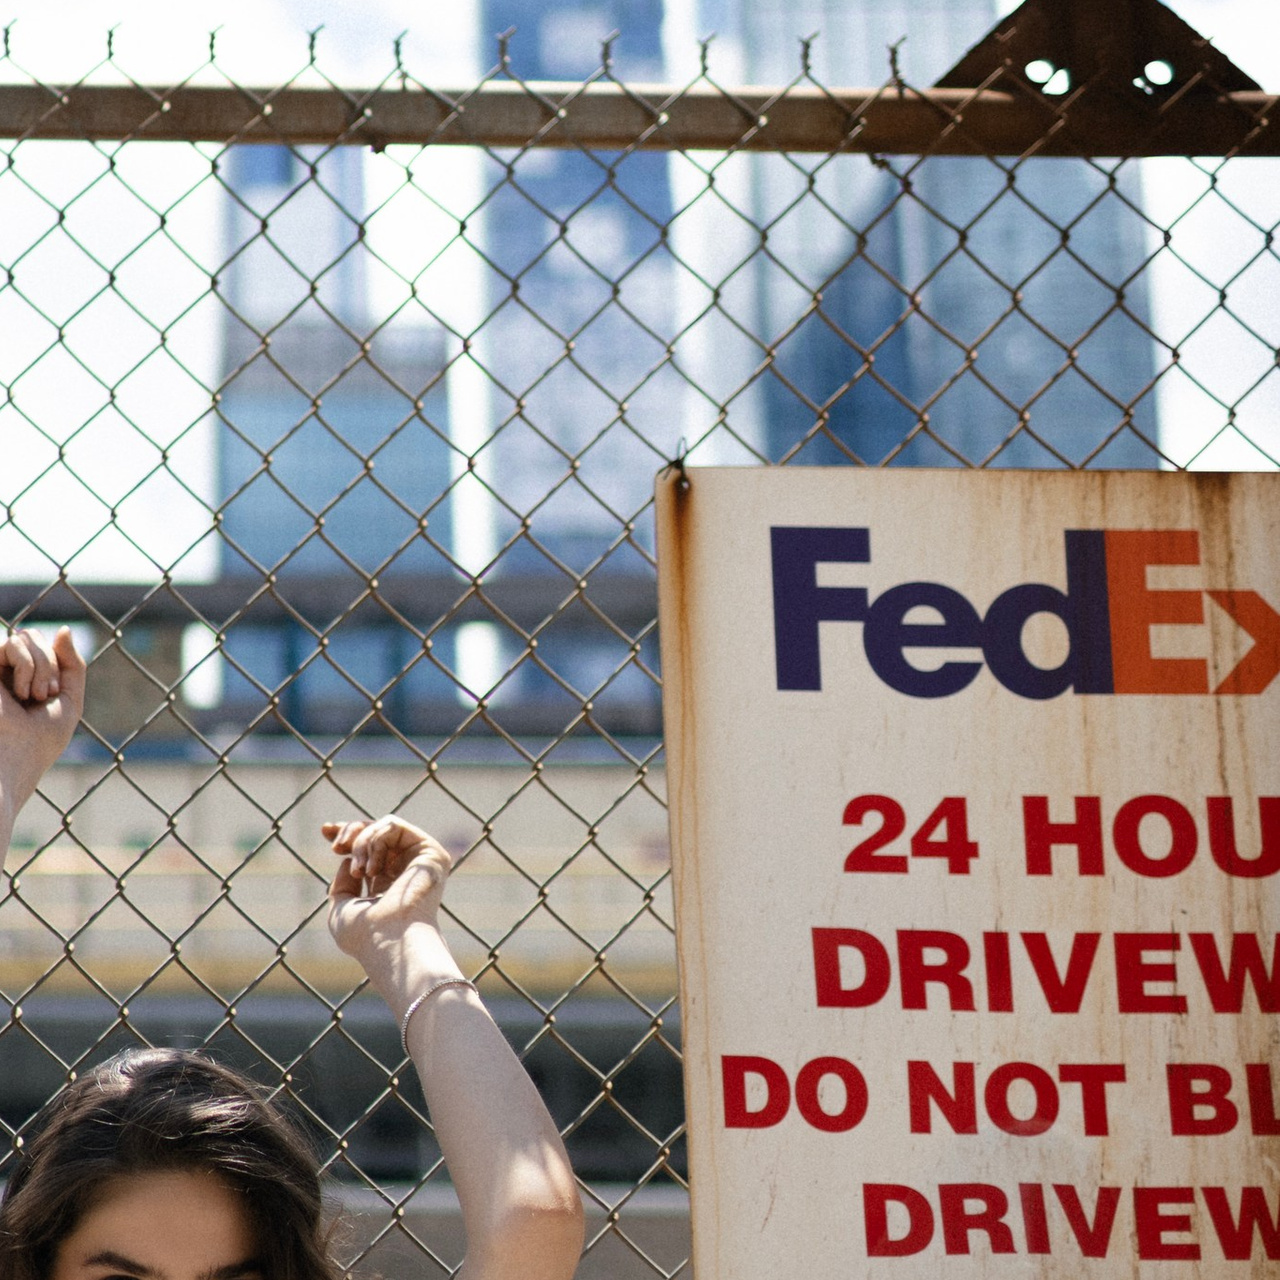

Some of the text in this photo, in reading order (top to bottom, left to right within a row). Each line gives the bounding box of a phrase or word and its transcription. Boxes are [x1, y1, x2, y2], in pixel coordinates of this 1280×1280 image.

[841, 793, 1280, 880] 24 HOU
[811, 926, 1280, 1015] DRIVEW
[720, 1054, 869, 1134] DO
[906, 1059, 1128, 1138] NOT
[862, 1182, 1280, 1262] DRIVEW
